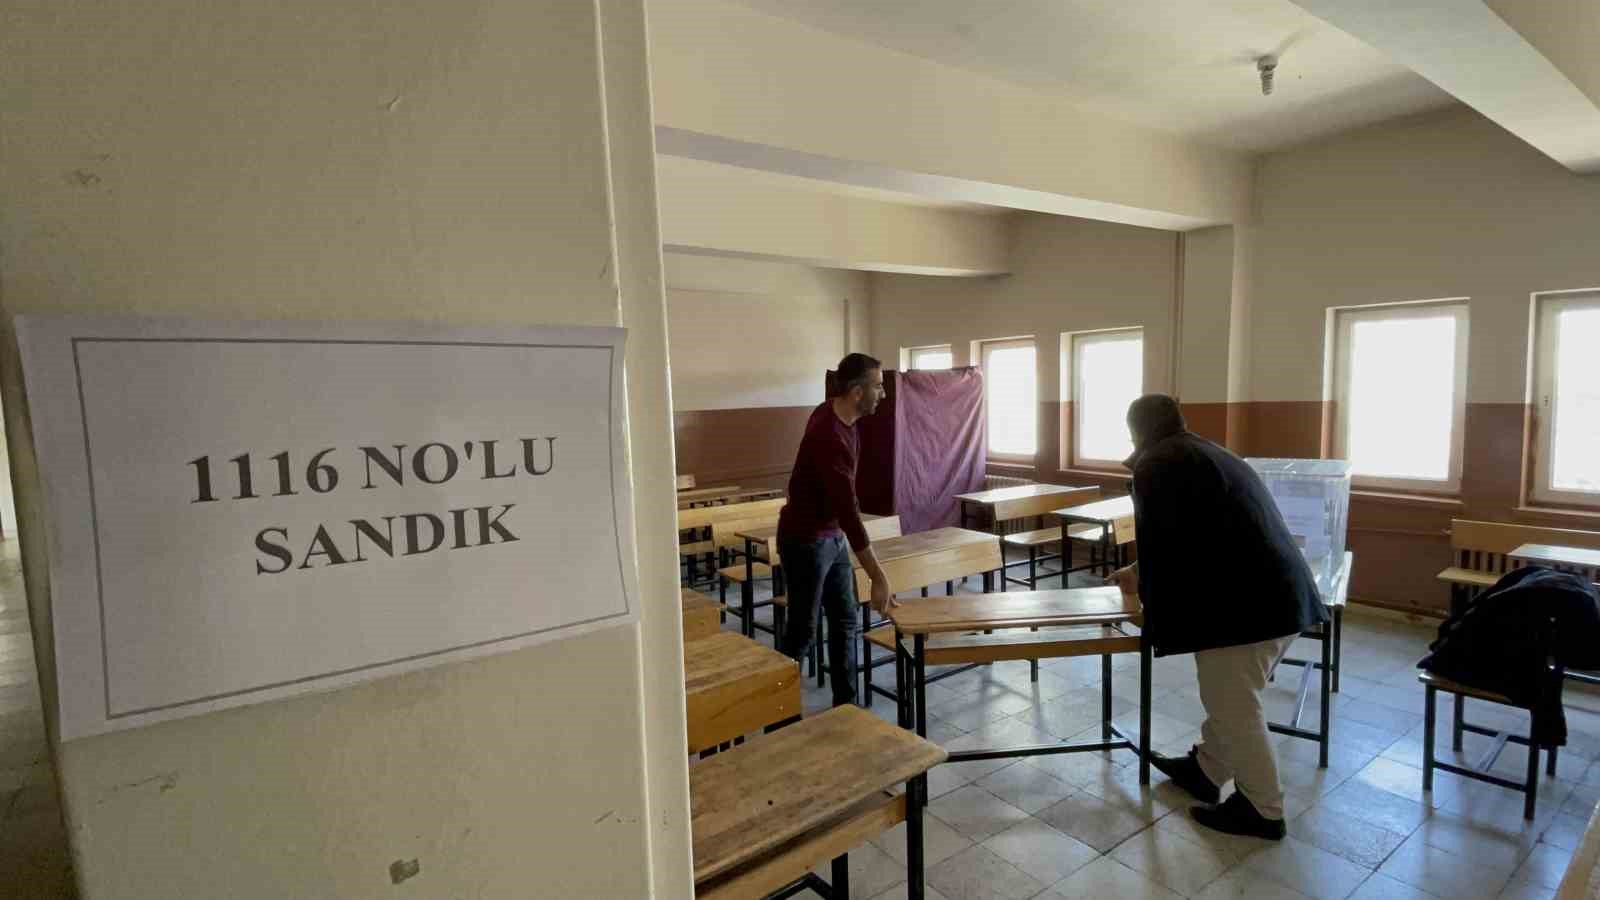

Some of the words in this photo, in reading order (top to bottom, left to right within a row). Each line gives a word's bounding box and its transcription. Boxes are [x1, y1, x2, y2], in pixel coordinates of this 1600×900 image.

[187, 447, 339, 504] 1116
[360, 436, 558, 490] NO'LU
[255, 503, 521, 577] SANDIK
